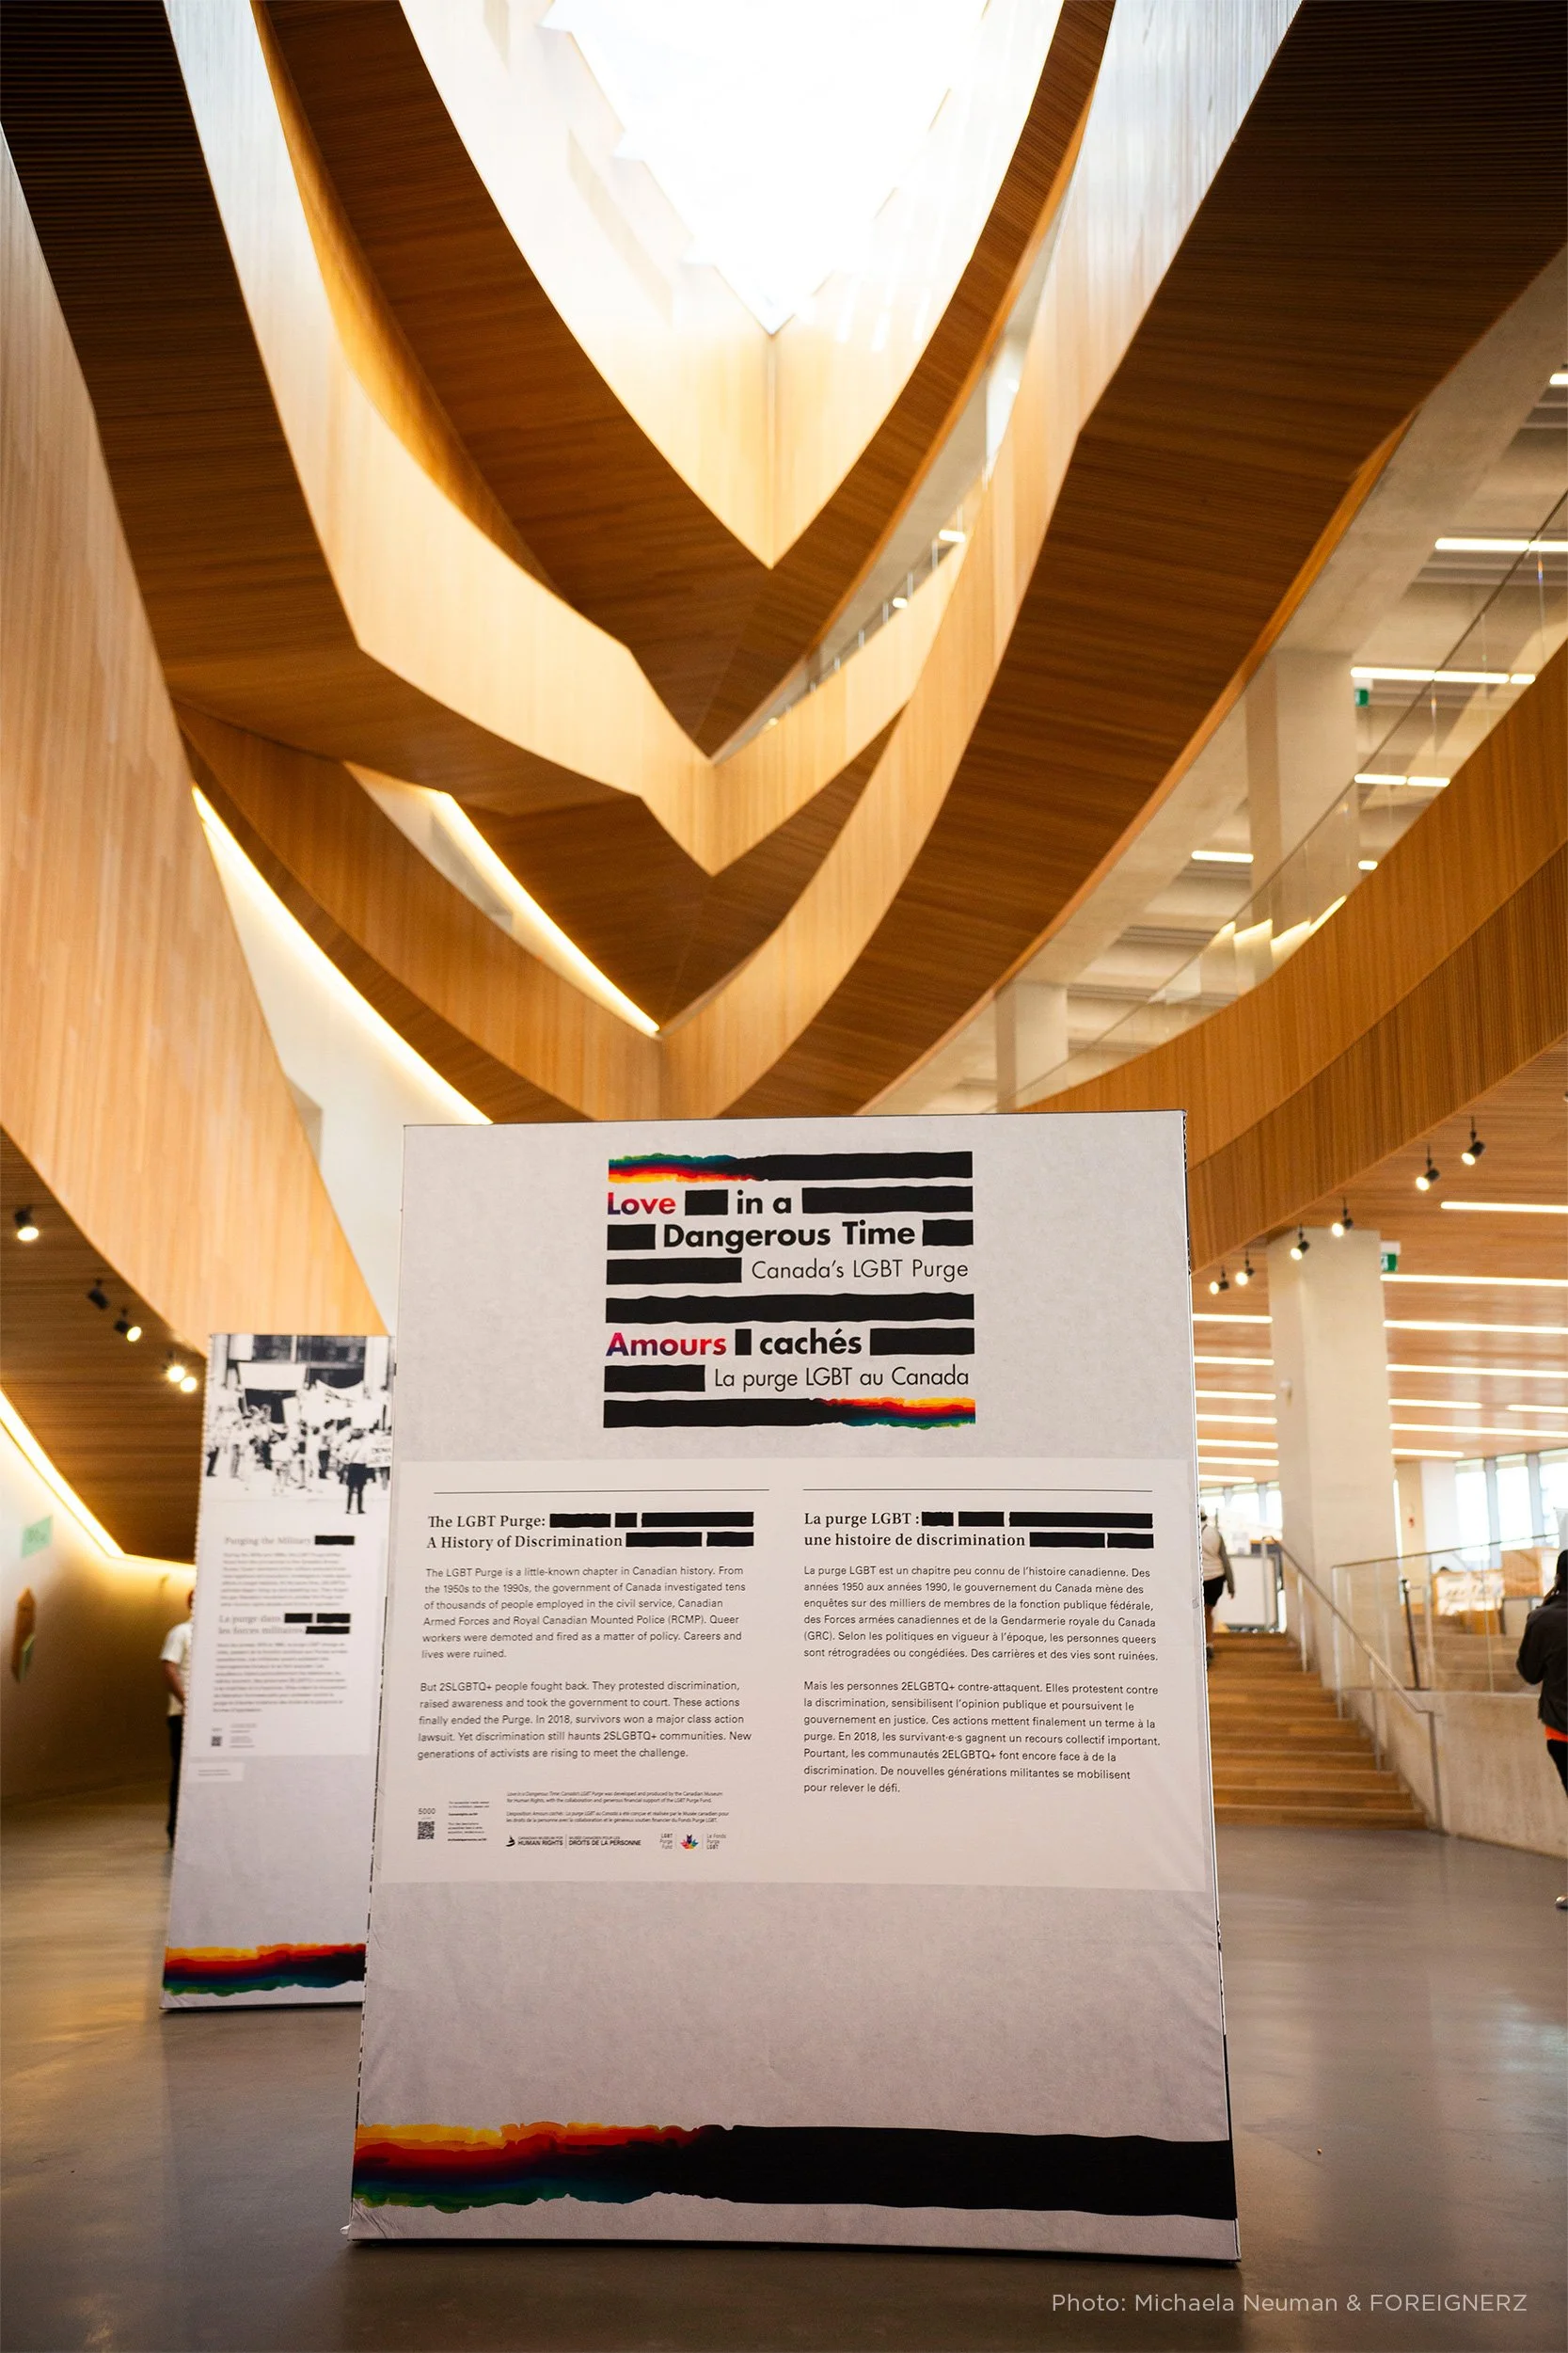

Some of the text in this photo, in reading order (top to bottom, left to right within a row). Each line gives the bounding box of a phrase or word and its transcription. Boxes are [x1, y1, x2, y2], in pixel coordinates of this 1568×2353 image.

[607, 1188, 791, 1215] Love in a
[663, 1220, 915, 1253] Dangerous Time
[752, 1257, 968, 1282] Canada's LGBT Purge
[605, 1327, 862, 1356] Amours cachés
[715, 1363, 968, 1392] La purge LGBT au Canada
[428, 1515, 545, 1530] The LGBT Purge:
[804, 1512, 820, 1524] La
[825, 1515, 866, 1528] purge
[871, 1512, 911, 1524] LGBT
[426, 1534, 622, 1550] A History of Discrimination
[804, 1533, 1024, 1546] une histoire de discrimination
[426, 1567, 443, 1577] The
[446, 1567, 472, 1577] LGBT
[474, 1567, 502, 1578] Purge
[505, 1567, 513, 1576] is
[525, 1567, 579, 1576] little-known
[582, 1566, 617, 1577] chapter
[621, 1566, 629, 1575] in
[632, 1566, 676, 1575] Canadian
[680, 1566, 715, 1576] history.
[718, 1566, 743, 1575] From
[804, 1566, 815, 1574] La
[817, 1567, 846, 1576] purge
[849, 1565, 876, 1575] LGBT
[911, 1566, 950, 1576] chapitre
[953, 1567, 971, 1576] peu
[1007, 1566, 1020, 1575] de
[1022, 1566, 1066, 1576] l'histoire
[1068, 1567, 1128, 1577] canadienne.
[1132, 1567, 1149, 1577] Des
[443, 1583, 469, 1593] 1950s
[502, 1583, 531, 1593] 1990s,
[534, 1583, 549, 1592] the
[552, 1583, 610, 1594] government
[612, 1582, 623, 1591] of
[625, 1582, 661, 1591] Canada
[664, 1582, 722, 1593] investigated
[803, 1598, 847, 1608] enquêtes
[869, 1598, 886, 1607] des
[889, 1598, 926, 1607] milliers
[928, 1598, 941, 1607] de
[943, 1598, 990, 1608] membres
[992, 1598, 1005, 1608] de
[1007, 1598, 1016, 1608] la
[1019, 1598, 1060, 1609] fonction
[1063, 1599, 1106, 1611] publique
[1109, 1599, 1153, 1611] fédérale,
[420, 1680, 739, 1692] But 2SLGBTQ+ people fought back. They protested discrimination,
[417, 1749, 475, 1760] generations
[477, 1748, 487, 1757] of
[489, 1748, 530, 1757] activists
[550, 1747, 578, 1759] rising
[620, 1747, 636, 1757] the
[638, 1747, 689, 1759] challenge.
[803, 1747, 847, 1758] Pourtant,
[851, 1748, 864, 1757] les
[867, 1749, 939, 1758] communautés
[942, 1749, 996, 1759] 2ELGBTQ+
[999, 1749, 1019, 1759] font
[1058, 1750, 1080, 1760] face
[1083, 1752, 1088, 1761] à
[1091, 1752, 1104, 1761] de
[1107, 1752, 1116, 1761] la
[803, 1782, 899, 1793] pour relever le défi.
